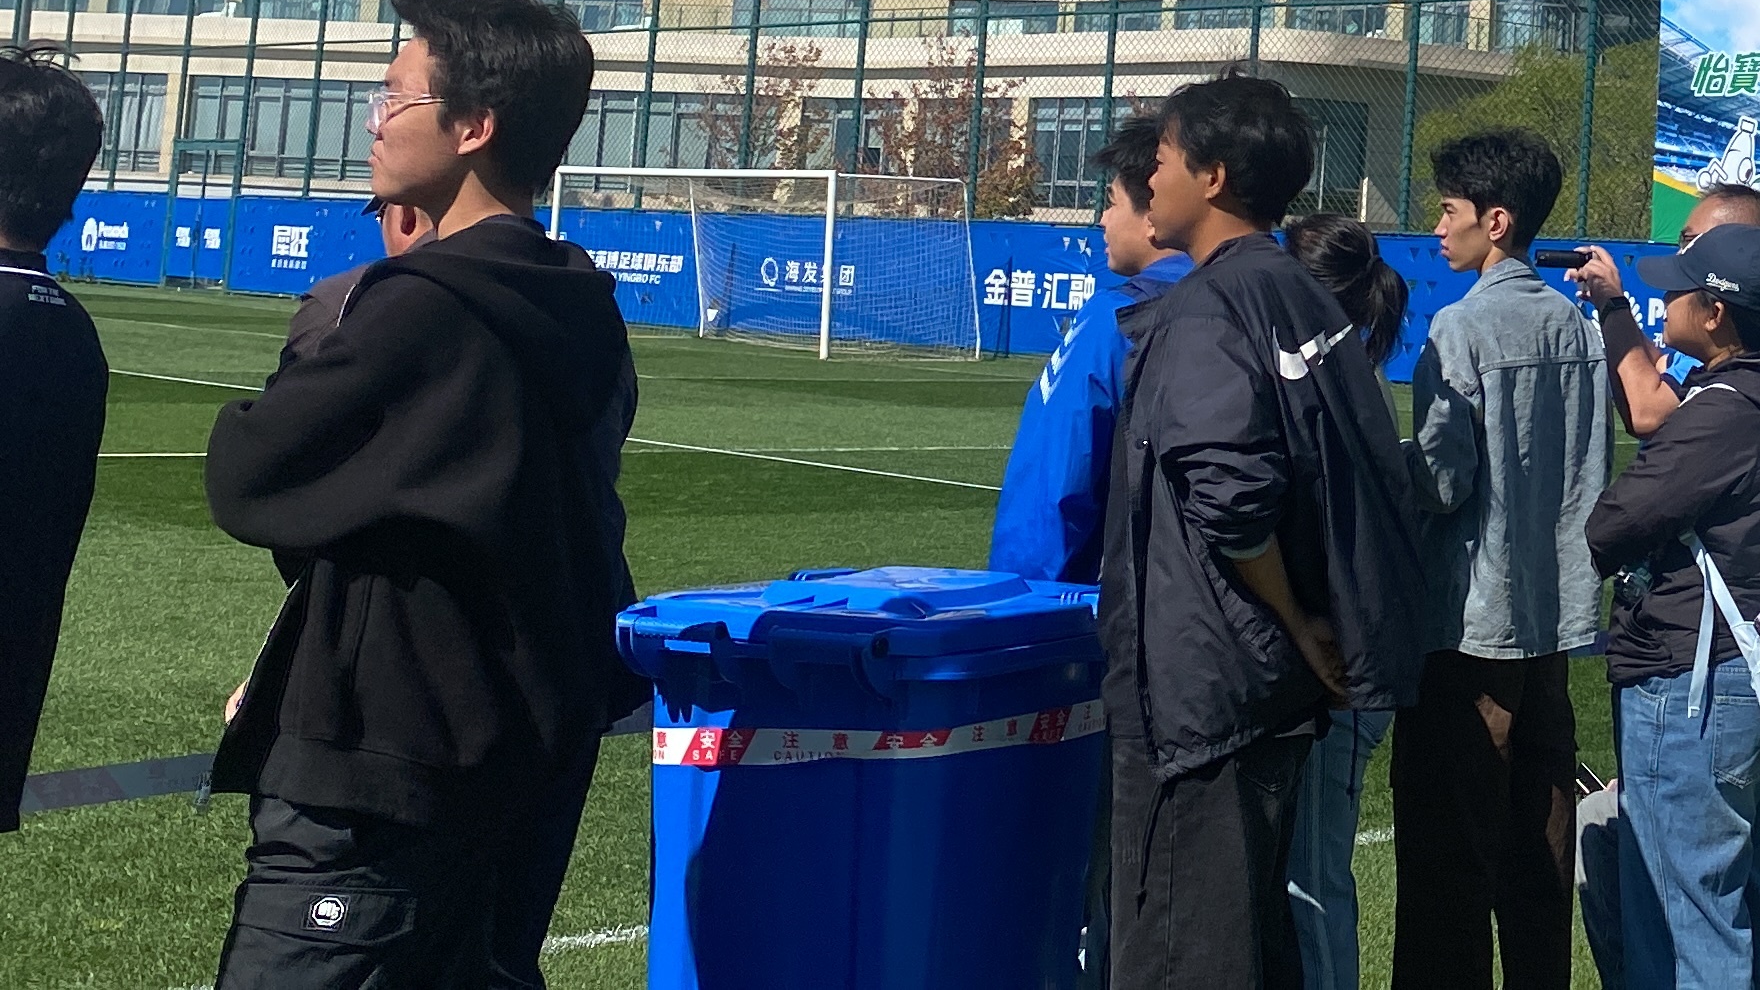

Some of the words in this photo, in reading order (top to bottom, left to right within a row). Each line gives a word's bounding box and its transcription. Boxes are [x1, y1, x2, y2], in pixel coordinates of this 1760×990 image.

[649, 274, 662, 285] FC
[785, 260, 855, 286] 海发团
[699, 729, 744, 750] 安全
[692, 749, 738, 761] SAFE
